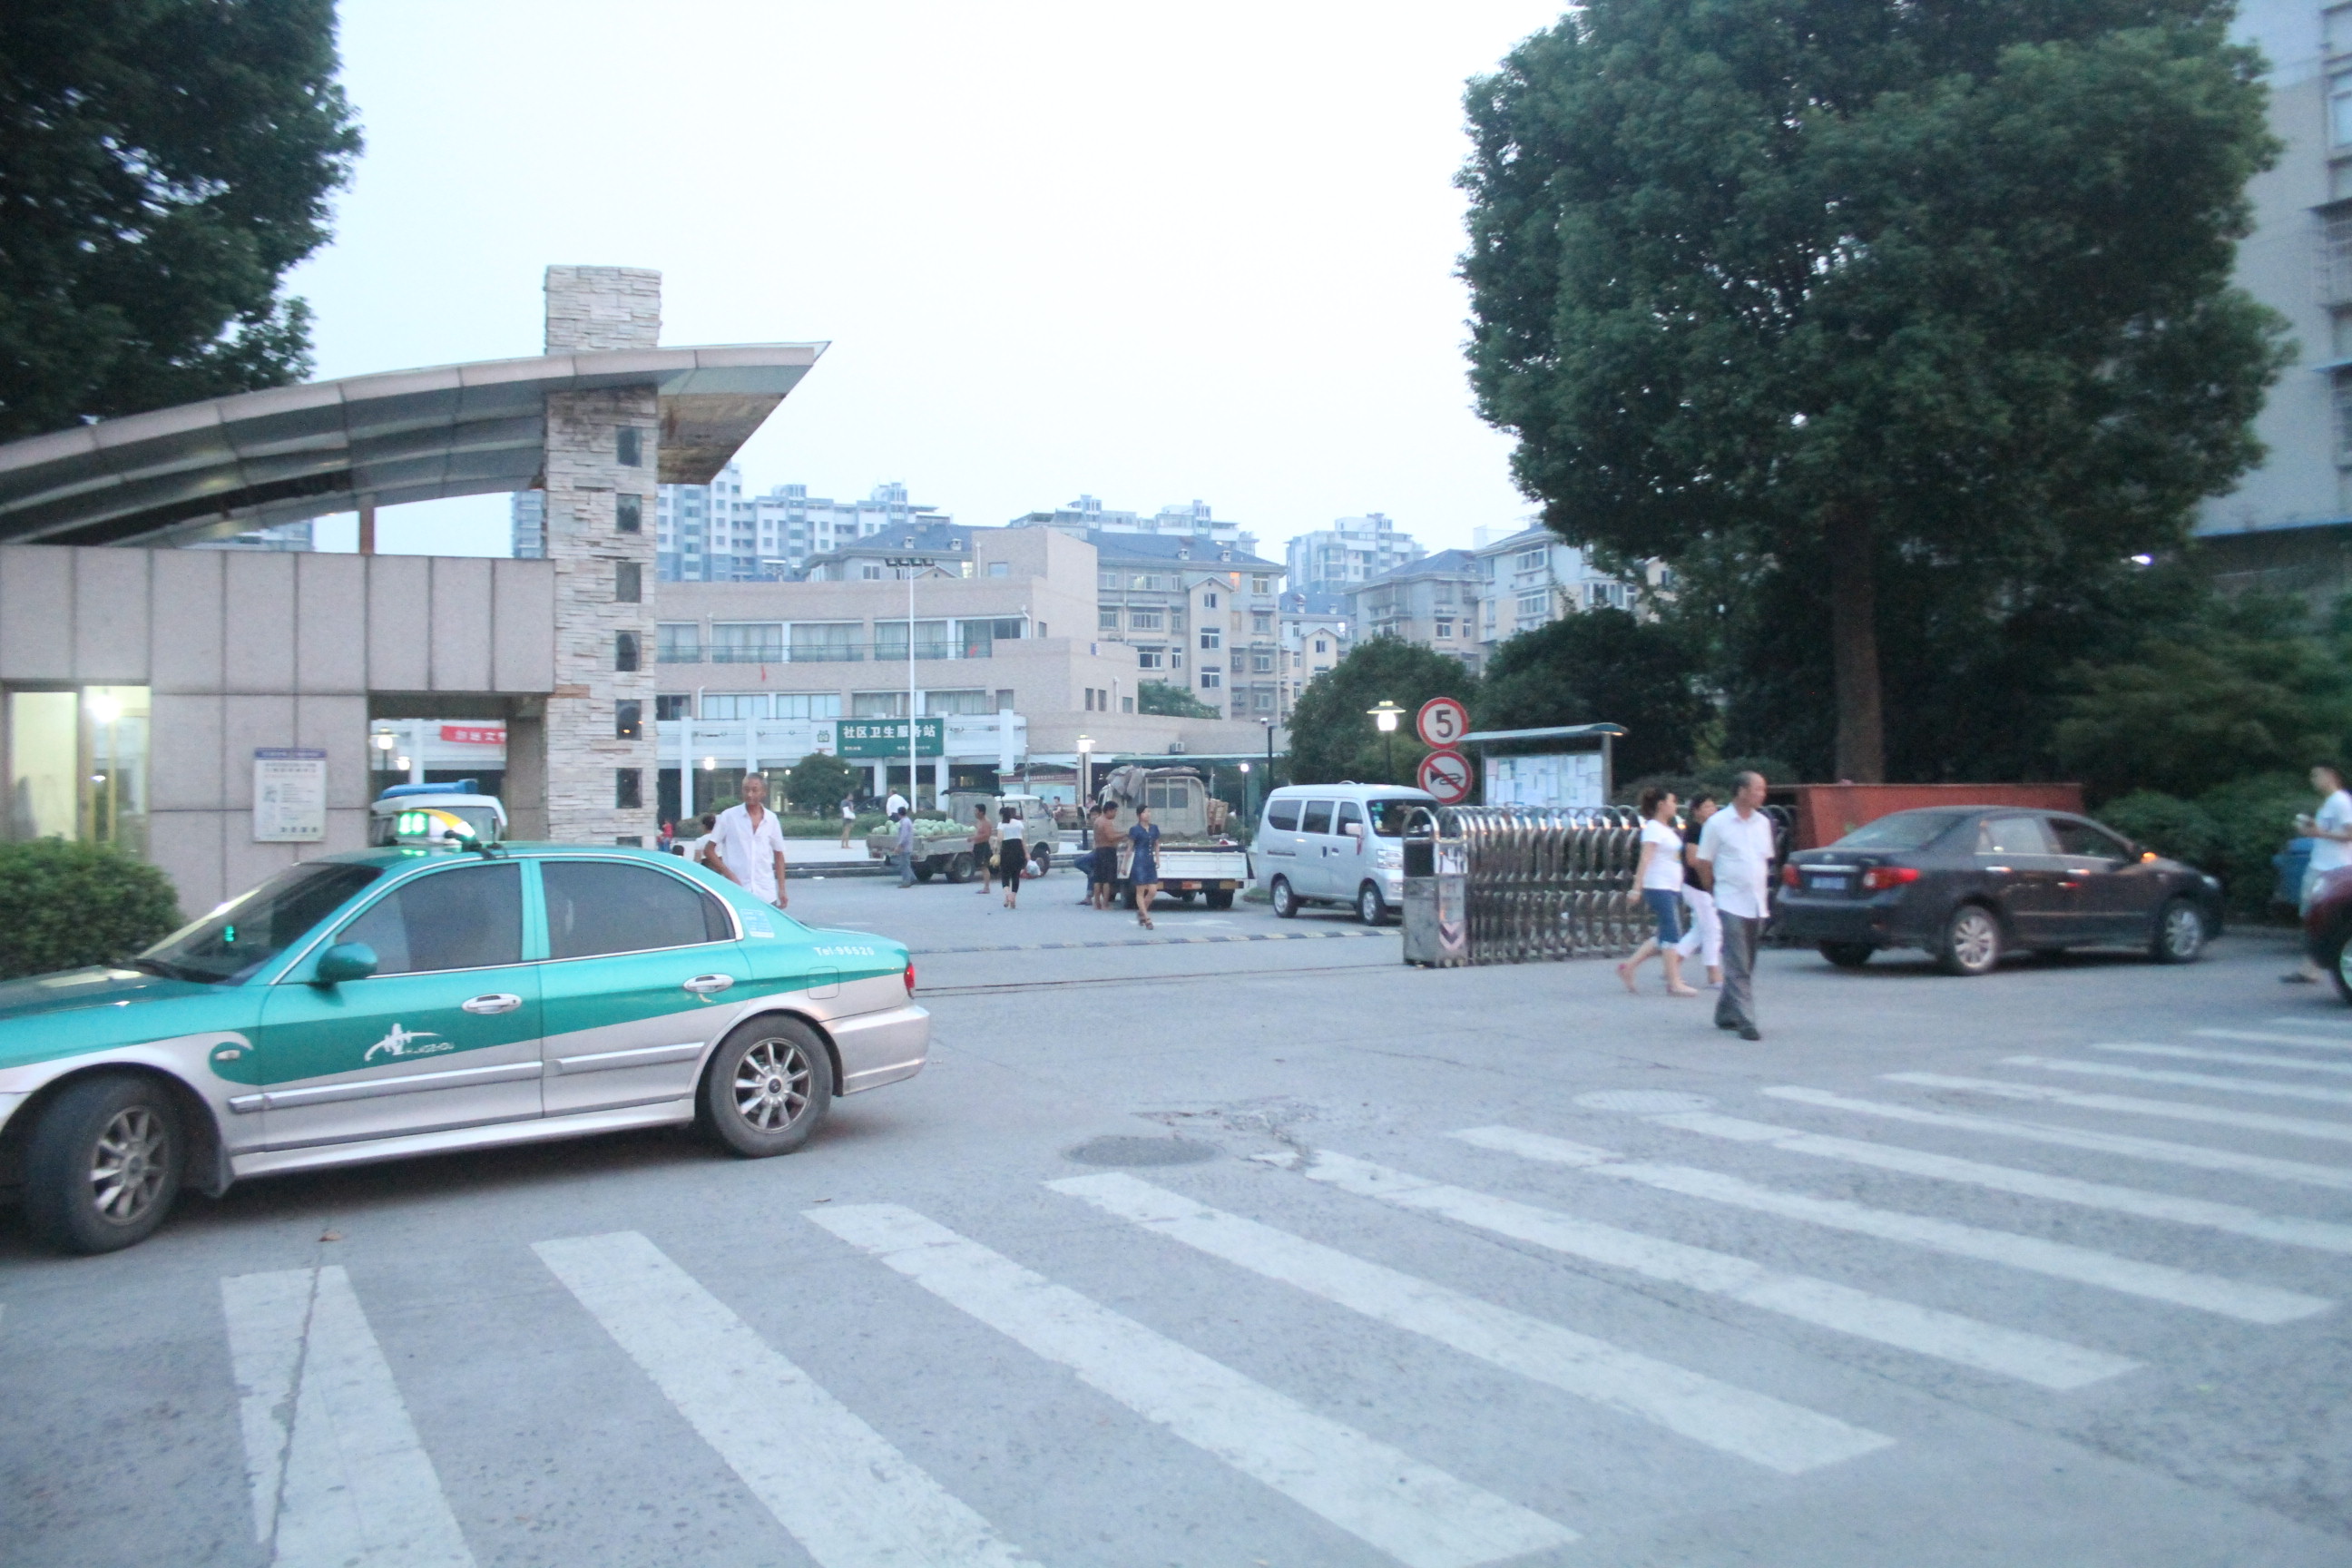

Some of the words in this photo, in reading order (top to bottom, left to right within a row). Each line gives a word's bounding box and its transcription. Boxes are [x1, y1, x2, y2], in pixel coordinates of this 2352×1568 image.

[843, 724, 936, 739] 社区卫生服务站
[1436, 710, 1454, 738] 5
